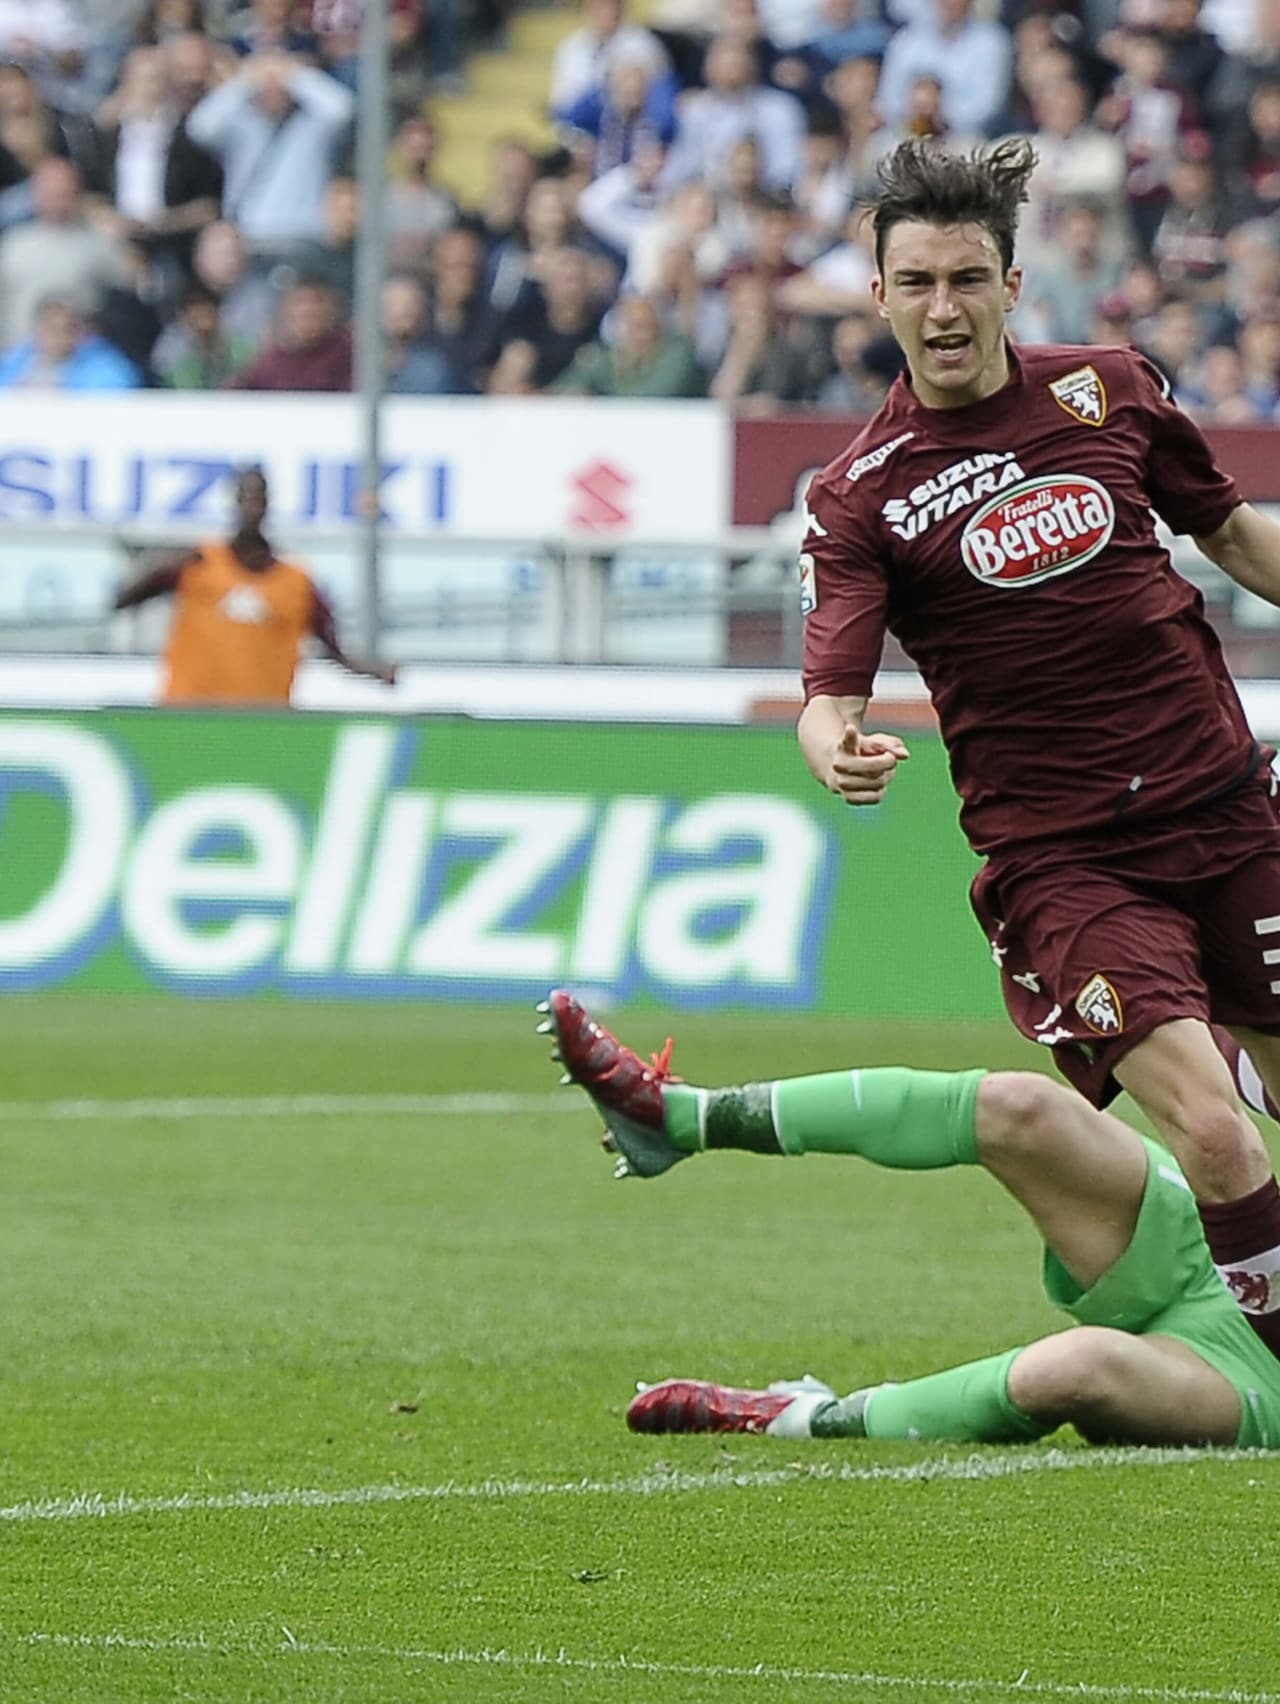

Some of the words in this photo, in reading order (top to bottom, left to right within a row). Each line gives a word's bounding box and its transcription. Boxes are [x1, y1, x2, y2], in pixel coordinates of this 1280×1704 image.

[848, 435, 910, 480] Kapp
[891, 461, 1026, 541] VITARA
[997, 489, 1055, 523] Fratelli
[967, 491, 1109, 577] Beretta
[1031, 546, 1070, 571] 1812
[0, 718, 832, 990] Delizia
